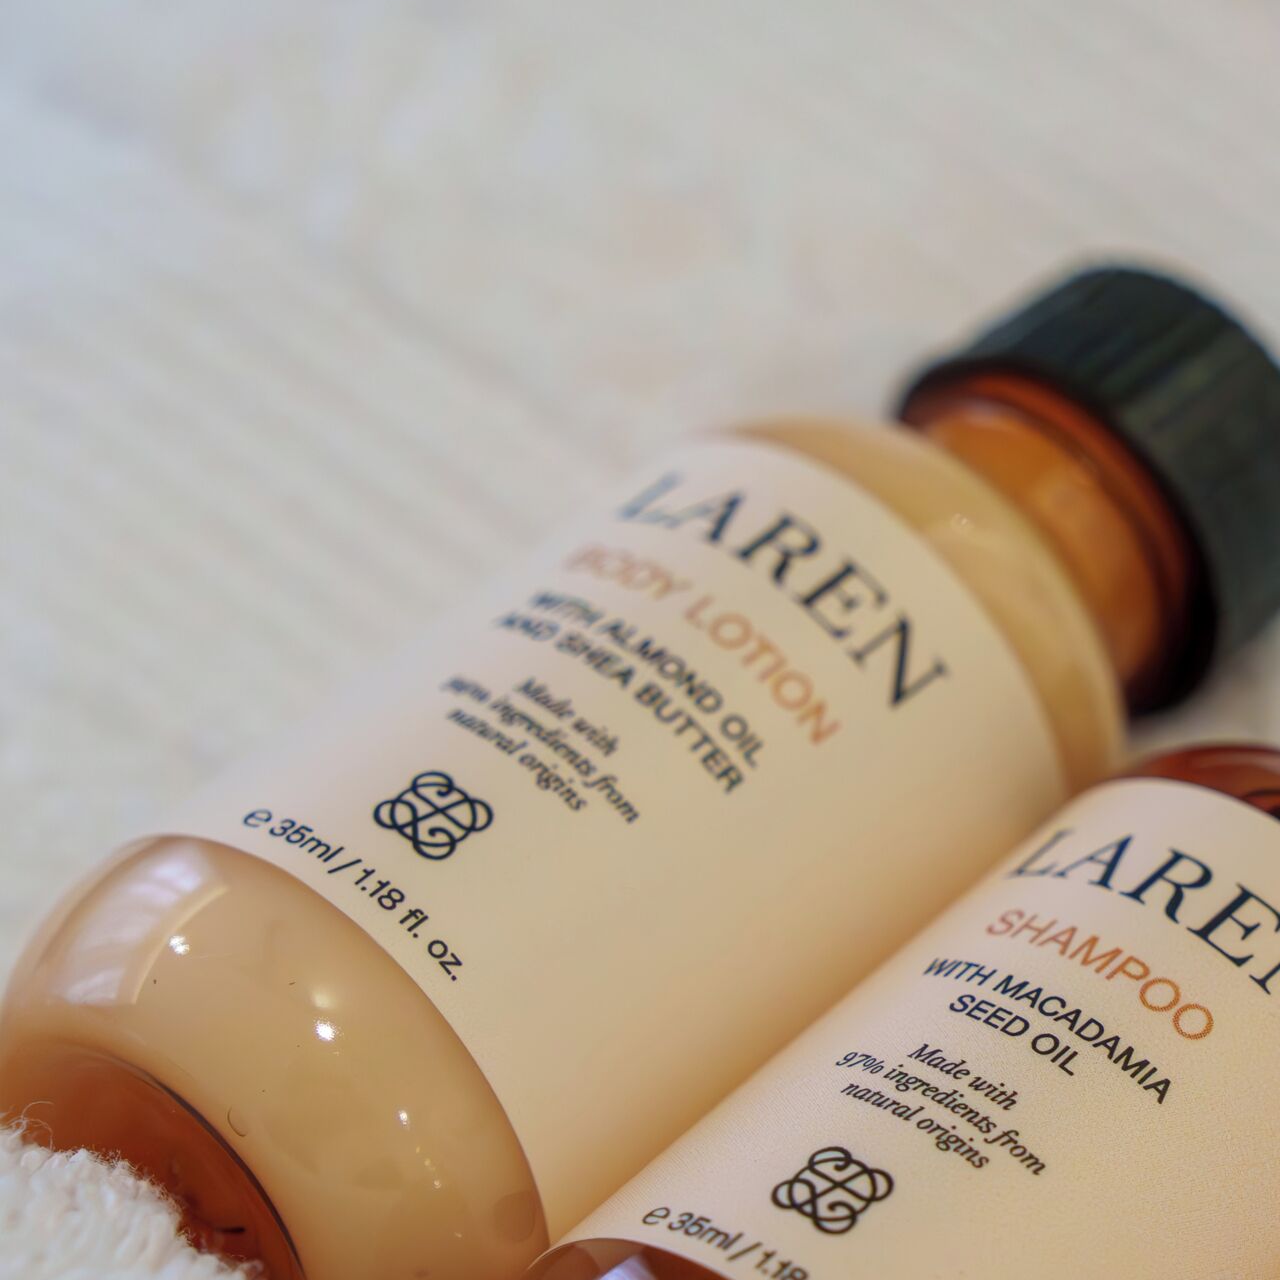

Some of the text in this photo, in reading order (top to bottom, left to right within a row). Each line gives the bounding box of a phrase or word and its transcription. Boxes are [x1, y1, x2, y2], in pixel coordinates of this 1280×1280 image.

[616, 472, 949, 710] LAREN
[513, 676, 576, 721] Made
[571, 717, 619, 758] with
[599, 618, 723, 710] ALMOND
[719, 713, 763, 769] OIL
[684, 594, 842, 747] LOTION
[446, 708, 588, 812] natural origins
[489, 696, 640, 824] ingredients from
[633, 681, 744, 794] BUTTER
[268, 817, 345, 863] 35ml
[354, 867, 406, 911] 1.18
[398, 908, 430, 939] fl.
[427, 939, 464, 982] oz.
[921, 957, 1173, 1105] WITH MACADAMIA
[948, 993, 1085, 1077] SEED OIL
[985, 908, 1215, 1041] SHAMPOO
[834, 1050, 1047, 1177] 97% ingredients from
[840, 1082, 991, 1170] natural origins
[906, 1042, 1019, 1112] Made with
[667, 1211, 744, 1252] 35ml
